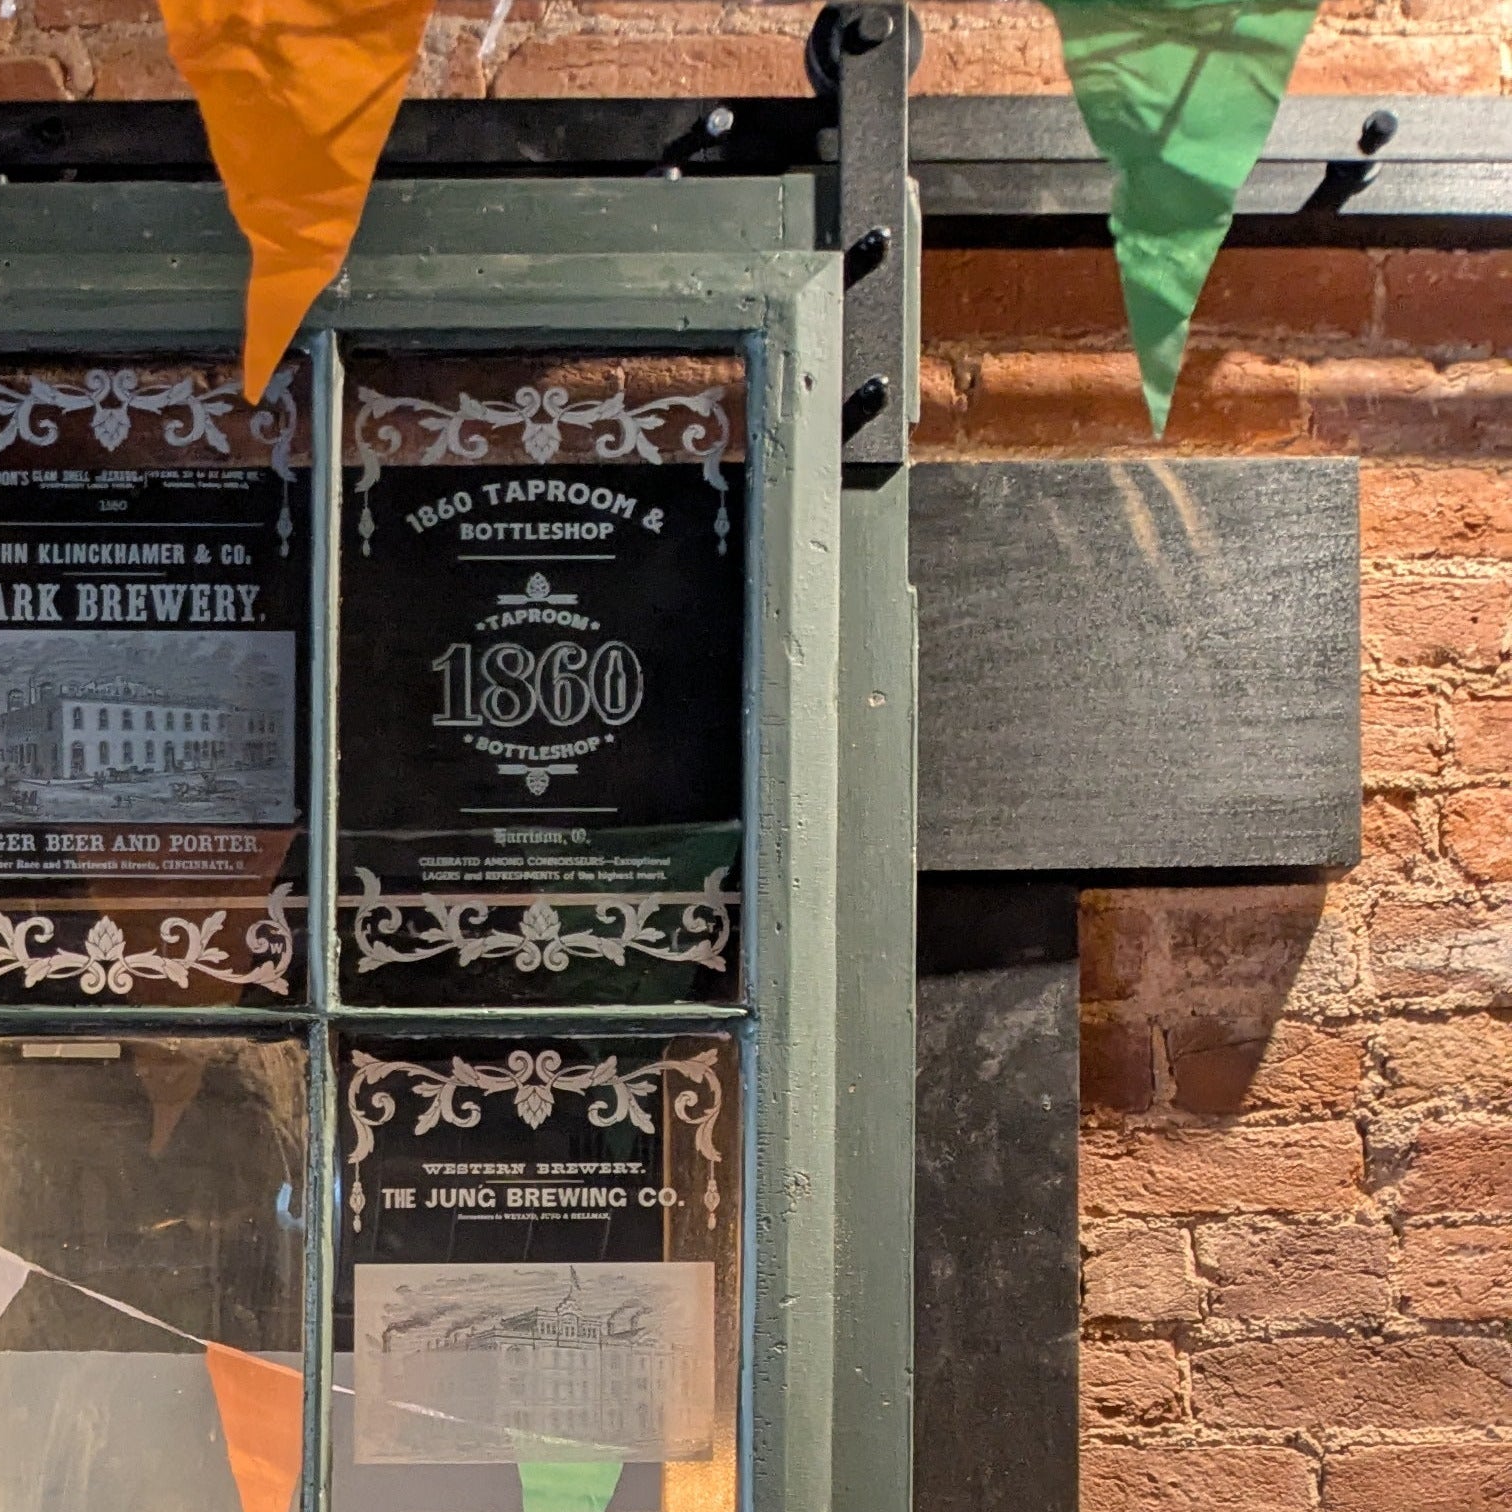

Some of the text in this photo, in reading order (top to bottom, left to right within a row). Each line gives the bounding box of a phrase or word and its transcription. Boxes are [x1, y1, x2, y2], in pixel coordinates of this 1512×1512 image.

[405, 478, 665, 535] 1860 TAPROOM &
[459, 522, 615, 541] BOTTLESHOP
[37, 542, 186, 565] KLINCKHAMER
[193, 542, 213, 565] &
[75, 582, 267, 623] BREWERY.
[484, 607, 590, 631] TAPROOM
[432, 639, 644, 727] 1860
[475, 735, 601, 761] BOTTLESHOP
[44, 832, 105, 852] BEER
[111, 833, 161, 853] AND
[168, 834, 264, 854] PORTER.
[42, 859, 61, 871] and
[463, 871, 483, 881] and
[269, 942, 283, 954] W
[421, 1162, 646, 1175] WESTERN BREWERY.
[381, 1186, 685, 1209] THE JUNG BREWING CO.
